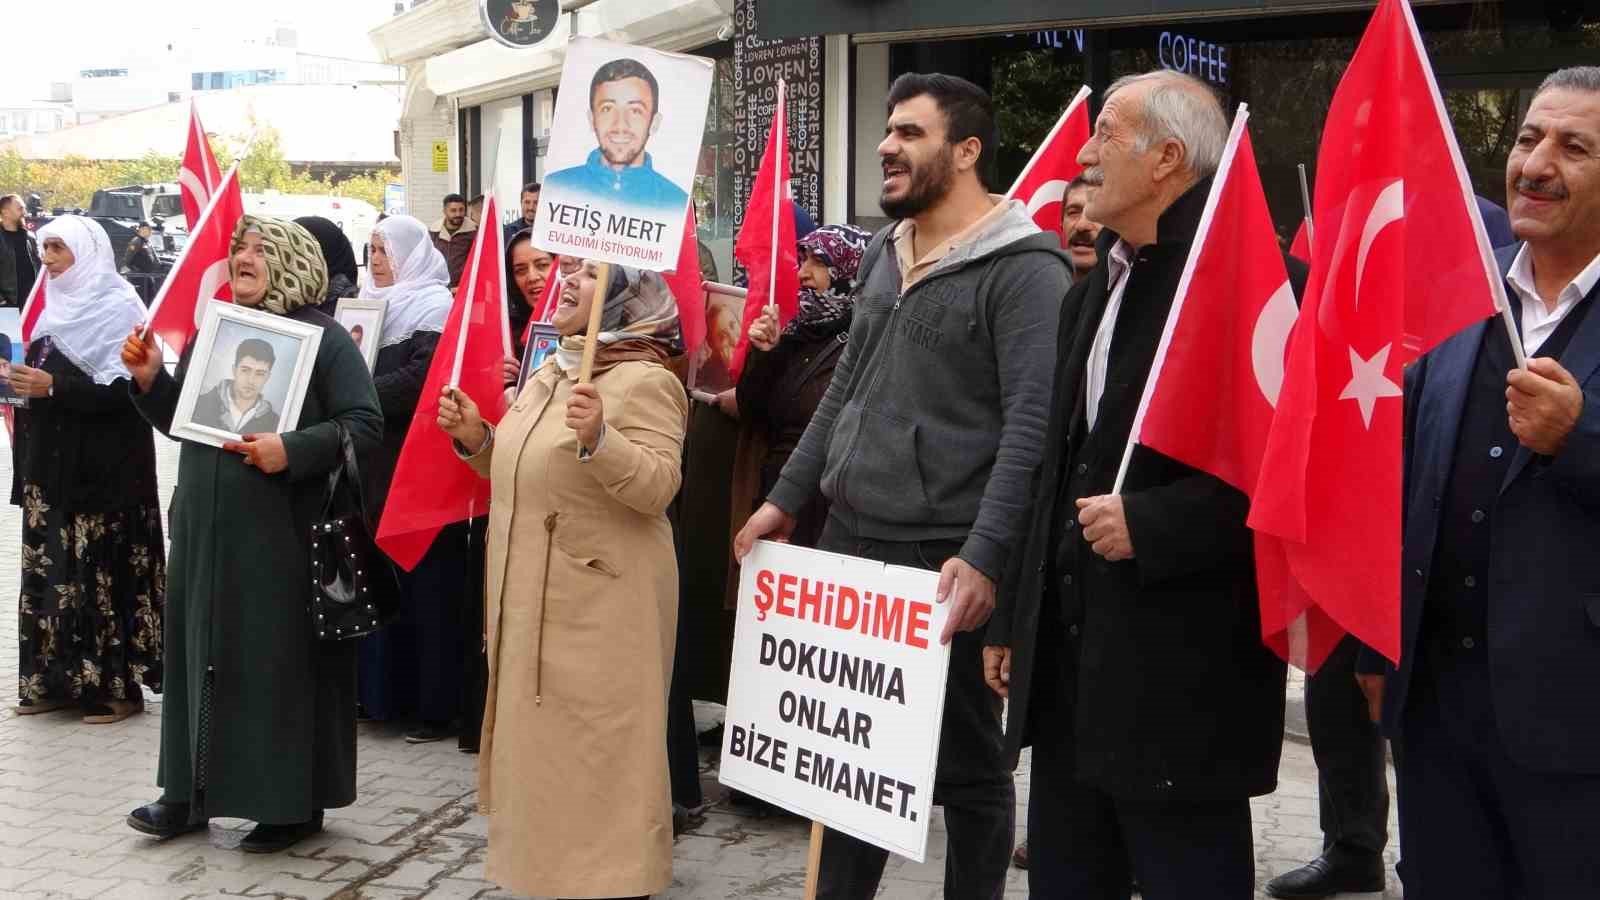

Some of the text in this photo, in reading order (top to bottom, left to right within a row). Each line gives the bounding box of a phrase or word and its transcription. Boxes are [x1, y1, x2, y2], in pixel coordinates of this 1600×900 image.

[735, 41, 743, 90] COFFEE
[744, 42, 808, 63] LOVREN LOVREN
[746, 58, 806, 86] LOVREN
[1159, 31, 1227, 83] COFFEE
[735, 90, 746, 176] LOVREN
[747, 93, 757, 151] COFFEE
[799, 97, 808, 150] COFFEE
[808, 71, 820, 149] LOVREN
[548, 202, 602, 236] YETİŞ
[607, 214, 667, 243] MERT
[734, 176, 743, 224] COFFEE
[810, 174, 818, 220] COFFEE
[548, 230, 599, 250] EVLADIMI
[760, 633, 906, 705] DOKUNMA
[779, 691, 872, 748] ONLAR
[730, 723, 918, 822] BİZE EMANET.
